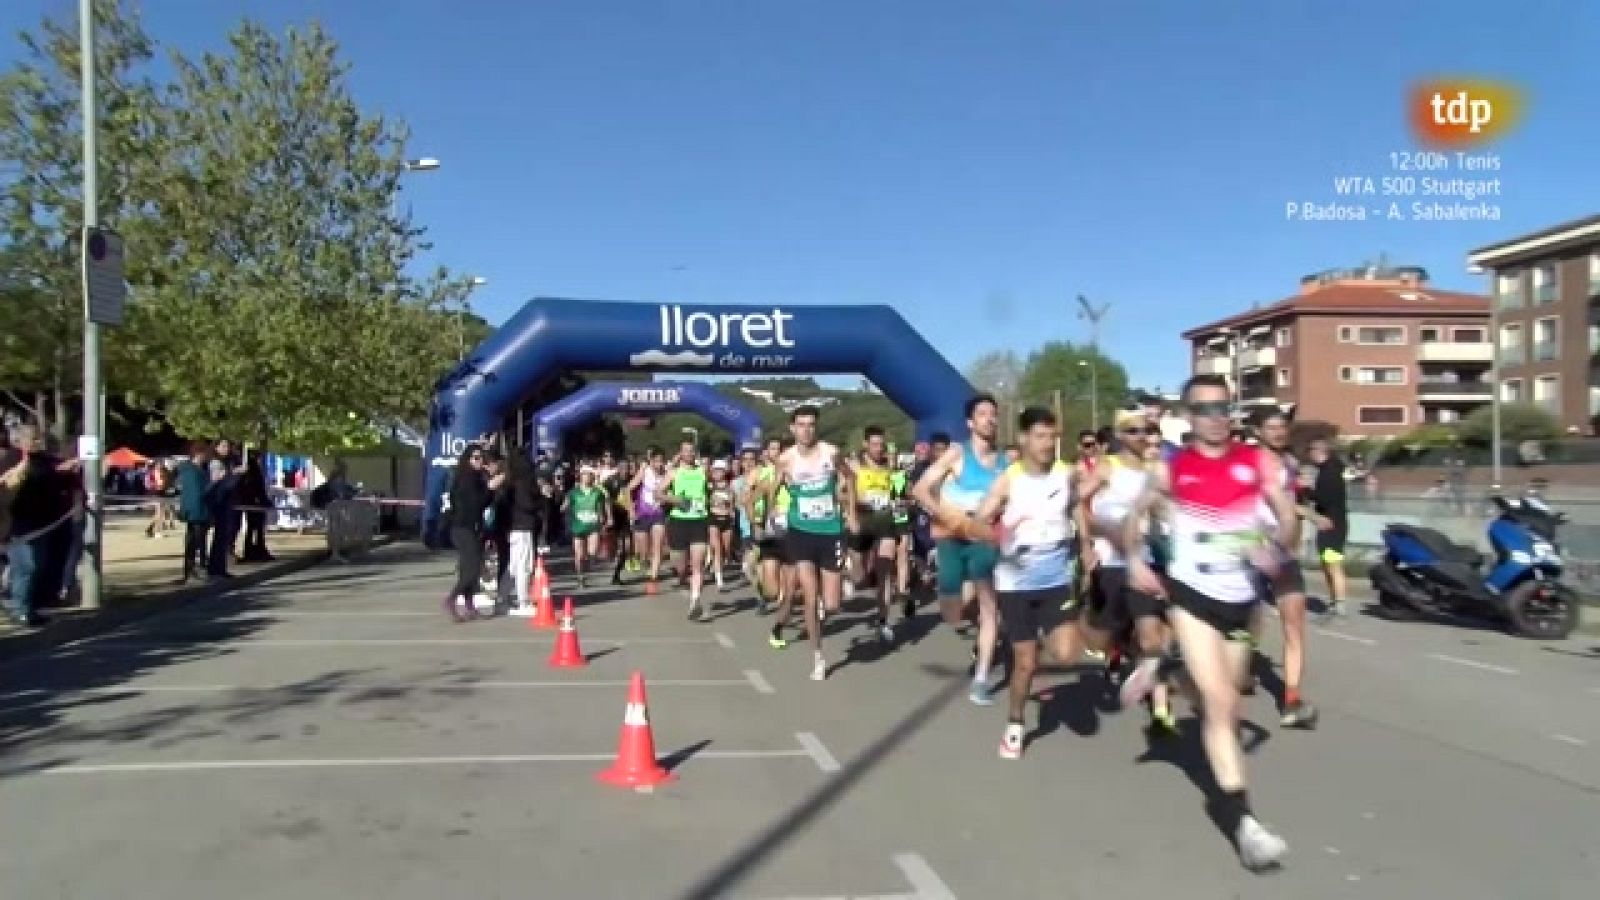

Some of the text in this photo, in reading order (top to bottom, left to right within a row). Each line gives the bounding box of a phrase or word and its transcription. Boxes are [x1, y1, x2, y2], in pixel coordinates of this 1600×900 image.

[660, 304, 795, 348] lloret
[719, 352, 794, 367] de mar
